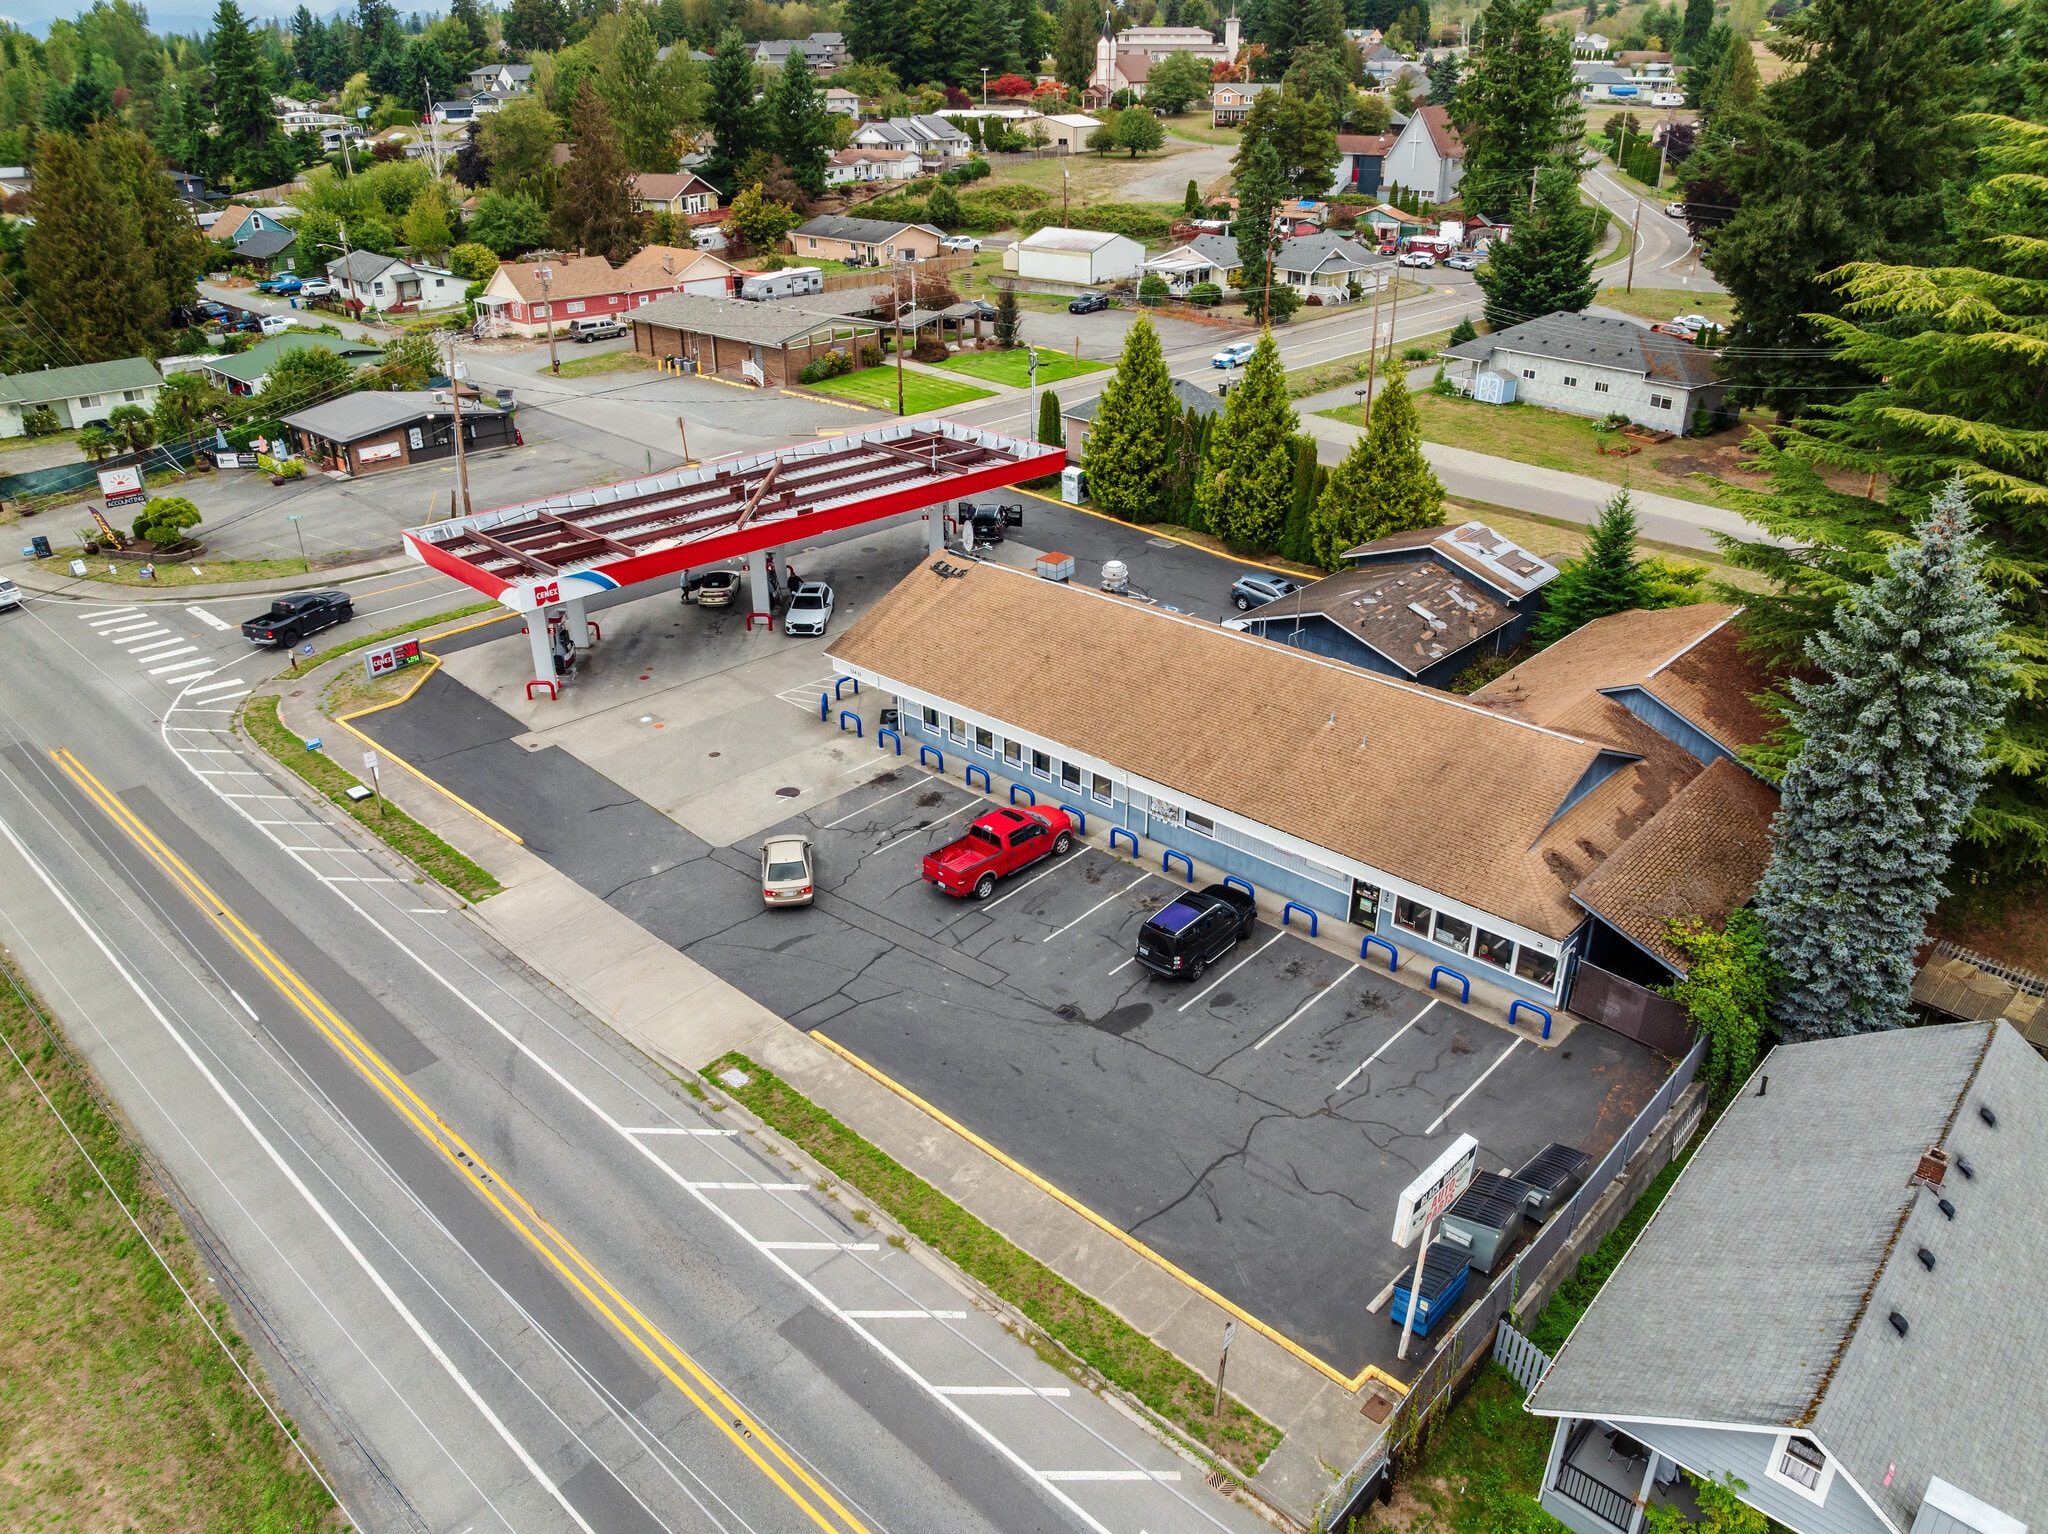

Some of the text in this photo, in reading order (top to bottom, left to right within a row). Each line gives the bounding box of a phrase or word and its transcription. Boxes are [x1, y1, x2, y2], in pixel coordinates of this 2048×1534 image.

[107, 495, 145, 507] ACCOUNTING
[536, 588, 558, 600] CENEX
[373, 656, 392, 667] CENEX
[1420, 1181, 1441, 1207] BLACK
[1431, 1178, 1456, 1209] AUTO
[1424, 1192, 1455, 1227] PARTS
